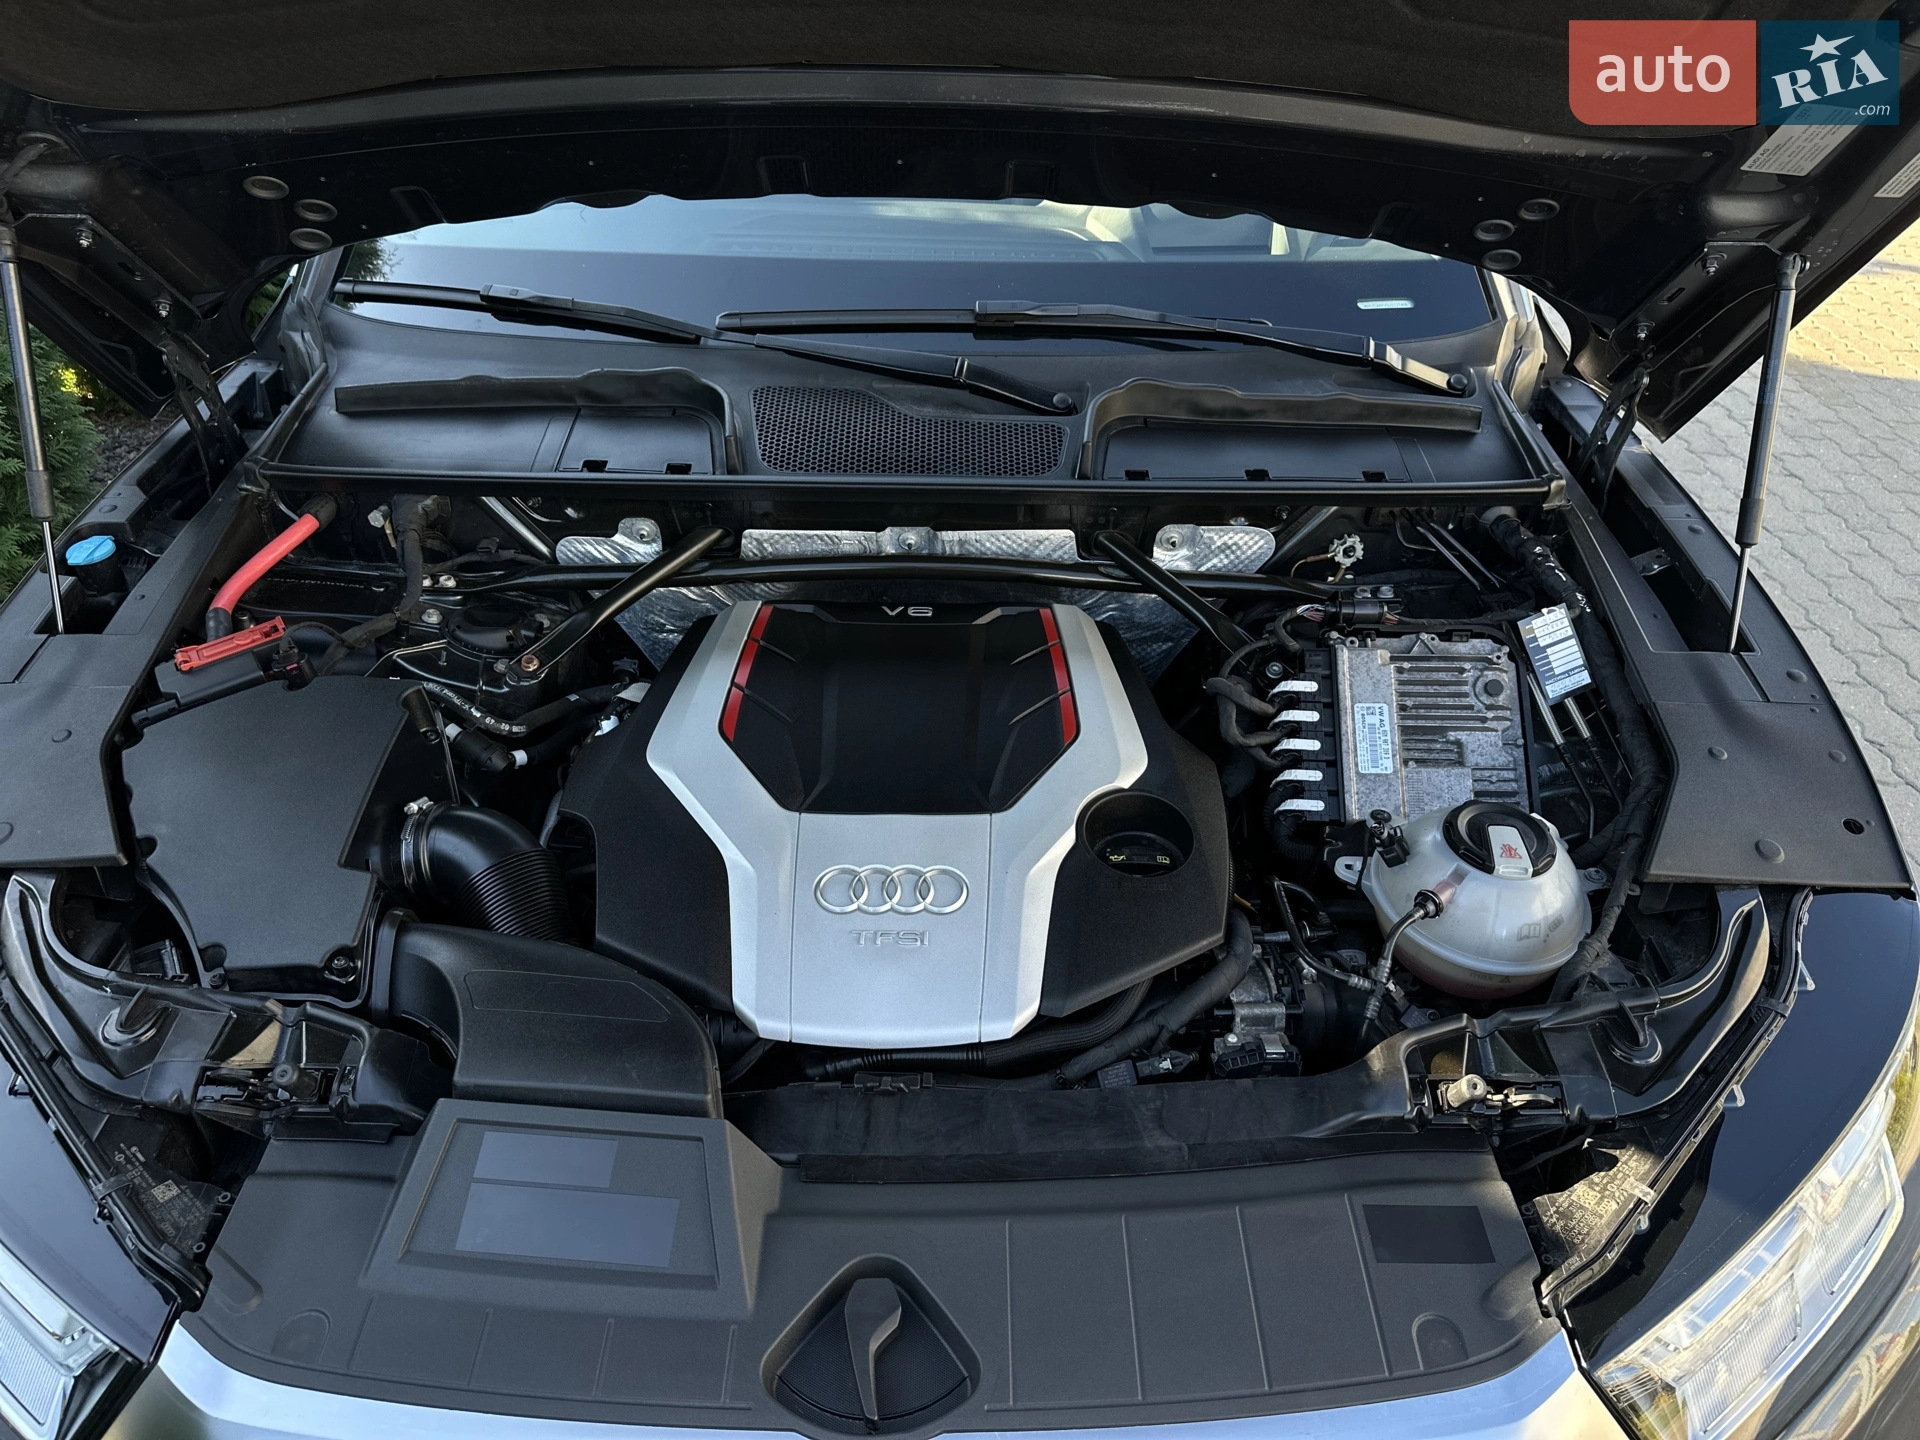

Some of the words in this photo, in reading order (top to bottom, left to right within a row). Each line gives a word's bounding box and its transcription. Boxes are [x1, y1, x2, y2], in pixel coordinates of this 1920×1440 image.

[881, 606, 933, 617] V6
[1378, 705, 1384, 717] VW
[1379, 718, 1385, 728] AG
[851, 929, 930, 947] TFSI
